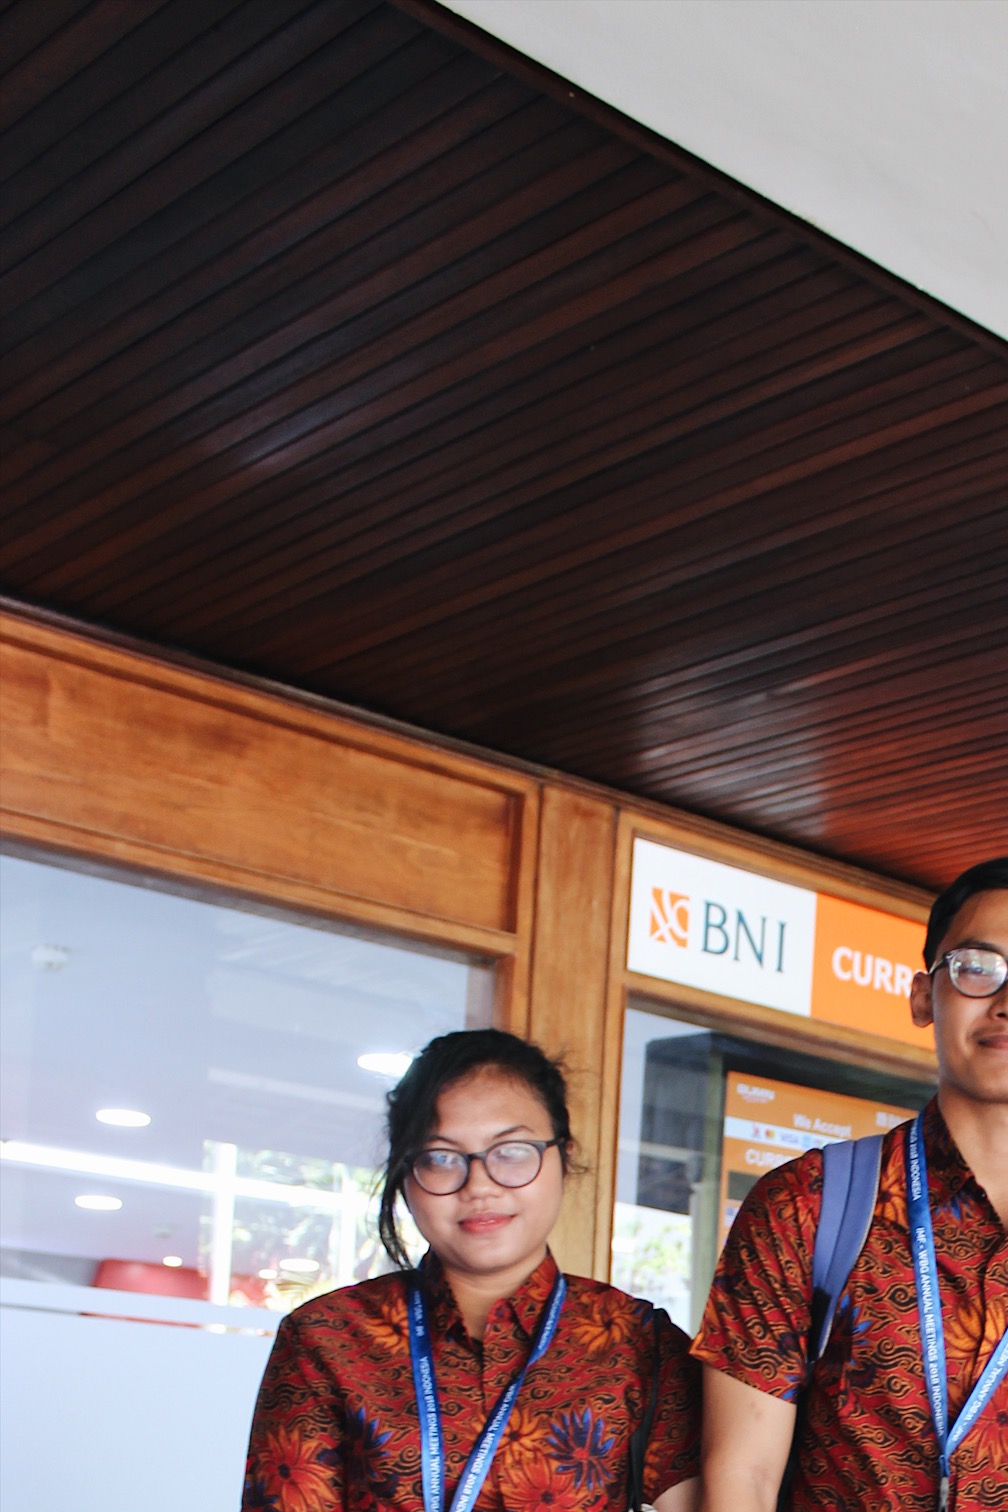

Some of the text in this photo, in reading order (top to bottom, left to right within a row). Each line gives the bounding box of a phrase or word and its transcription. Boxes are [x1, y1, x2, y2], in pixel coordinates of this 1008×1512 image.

[701, 899, 788, 973] BNI
[832, 946, 917, 999] CURR
[910, 1158, 922, 1202] INDONESIA
[915, 1227, 927, 1245] IMF
[918, 1249, 930, 1275] WBG
[920, 1276, 933, 1314] ANNUAL
[924, 1315, 938, 1362] MEETINGS
[419, 1356, 434, 1395] INDONESIA
[929, 1362, 940, 1385] 2018
[978, 1367, 1003, 1400] ANNUAL
[425, 1395, 437, 1414] 2018
[488, 1402, 510, 1433] ANNUAL
[931, 1385, 945, 1437] INDONESIA
[427, 1413, 440, 1454] MEETINGS
[472, 1430, 496, 1476] MEETINGS
[429, 1455, 441, 1495] ANNUAL
[463, 1472, 478, 1494] 2018
